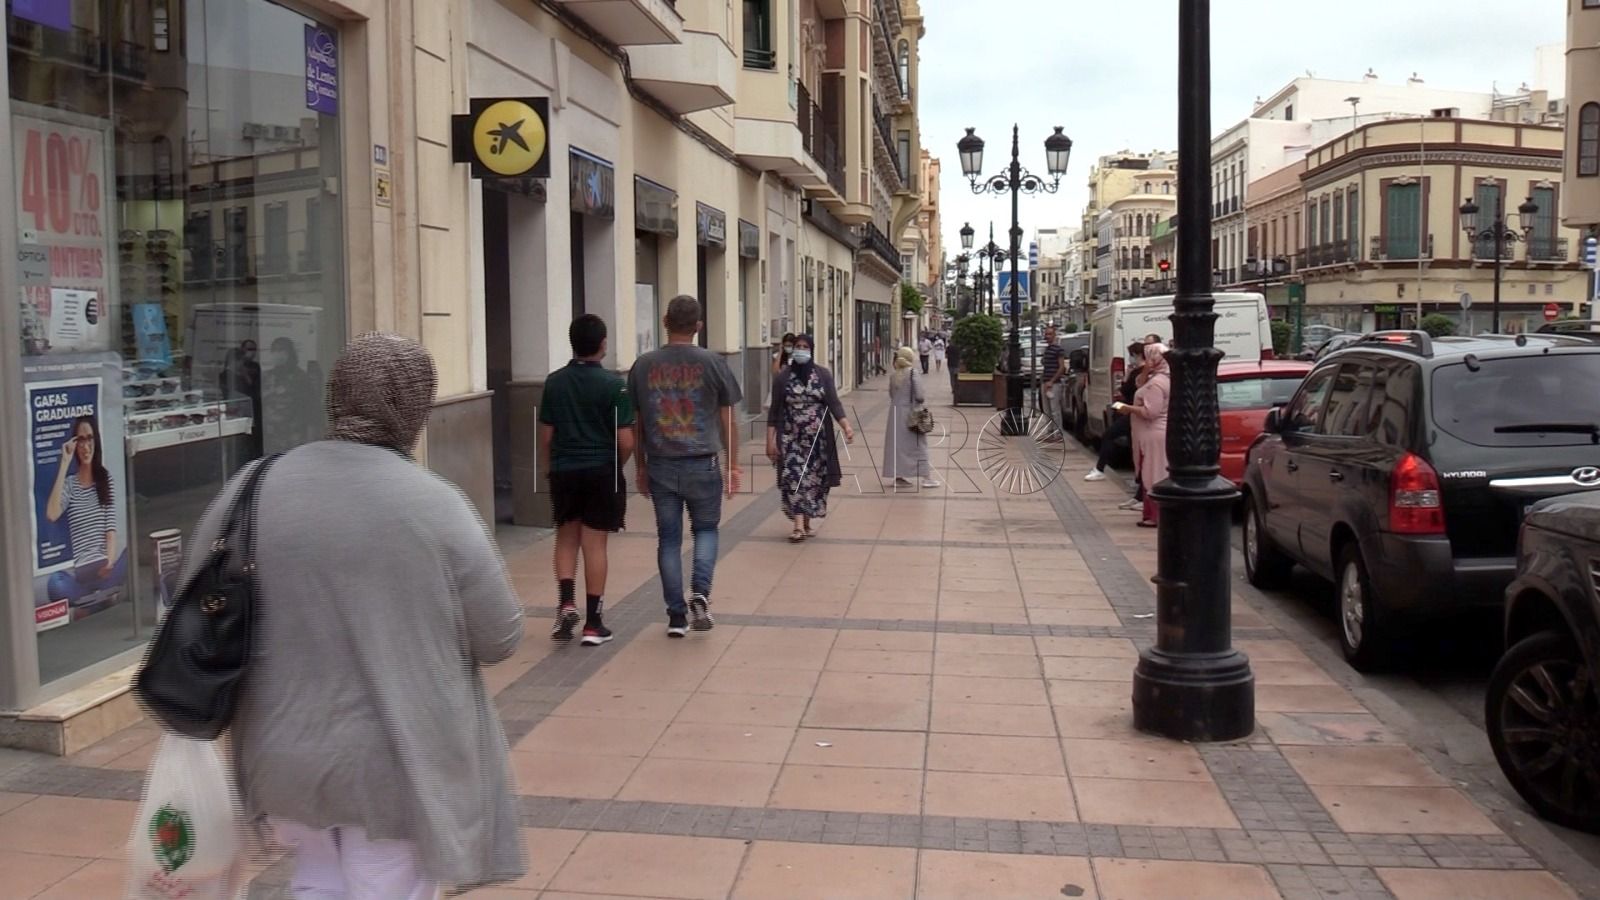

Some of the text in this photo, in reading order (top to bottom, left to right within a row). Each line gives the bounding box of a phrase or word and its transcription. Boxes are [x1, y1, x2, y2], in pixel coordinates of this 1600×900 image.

[22, 129, 100, 234] 40%
[34, 393, 68, 408] GAFAS
[36, 404, 94, 422] GRADUADAS
[1443, 470, 1487, 479] HYUNDAI
